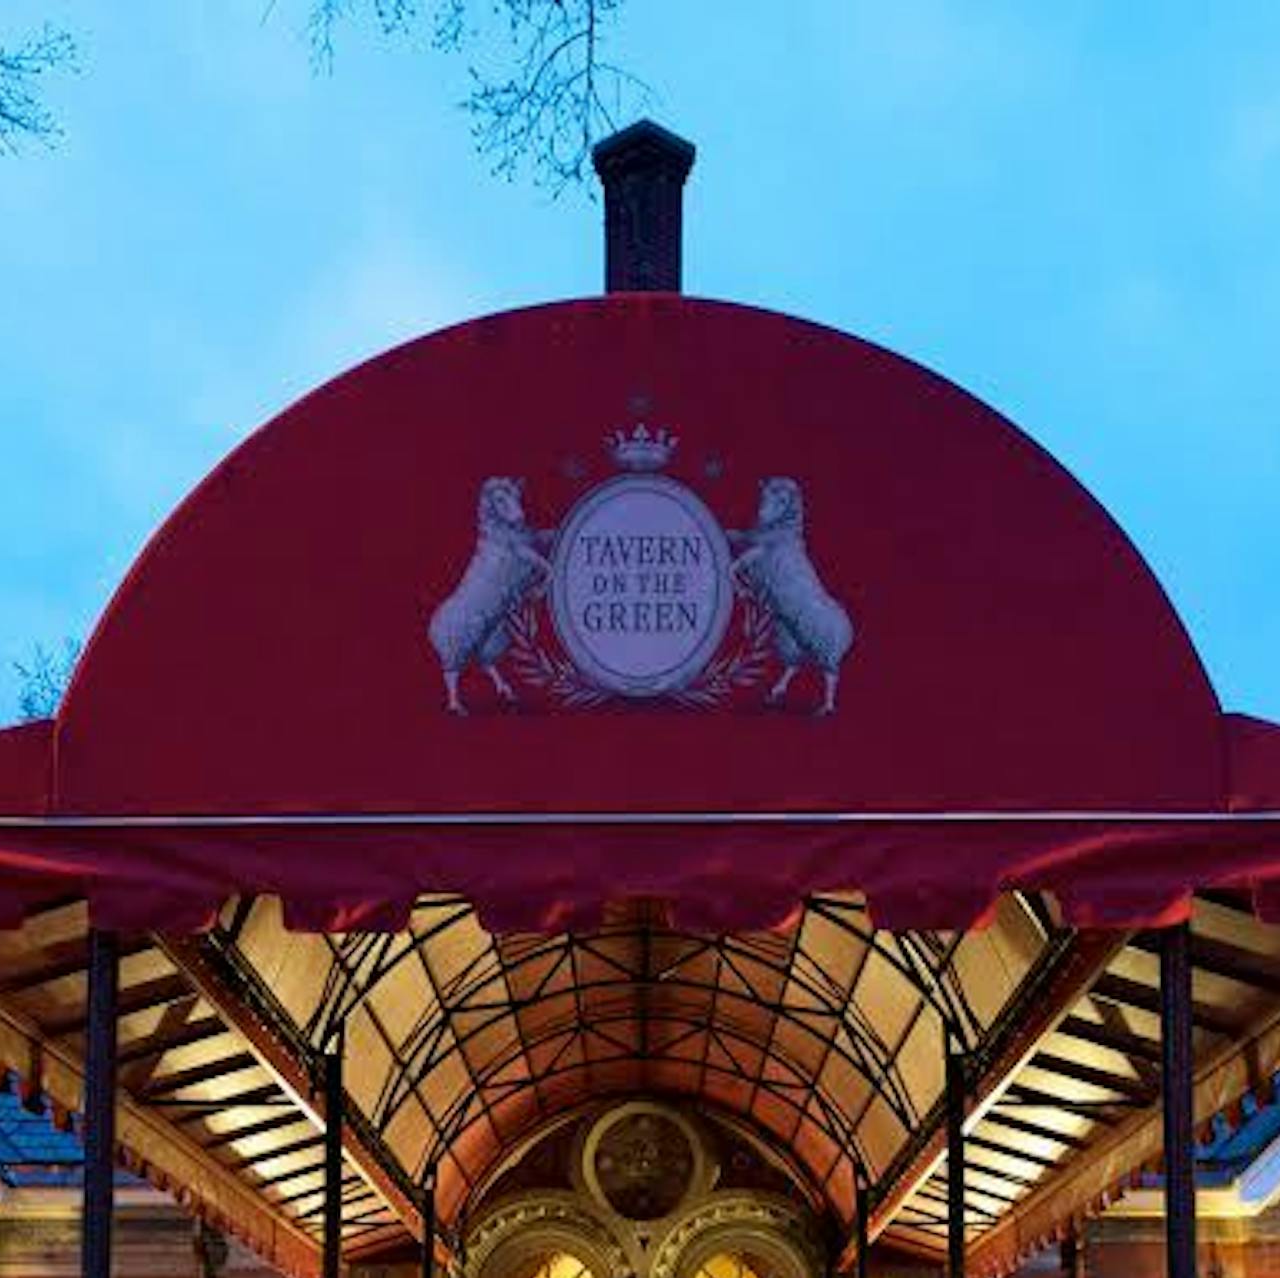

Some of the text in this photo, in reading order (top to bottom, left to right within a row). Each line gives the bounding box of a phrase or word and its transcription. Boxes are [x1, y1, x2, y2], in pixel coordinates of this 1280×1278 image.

[580, 535, 701, 565] TAVERN
[592, 573, 685, 594] ON THE
[583, 602, 698, 631] GREEN
